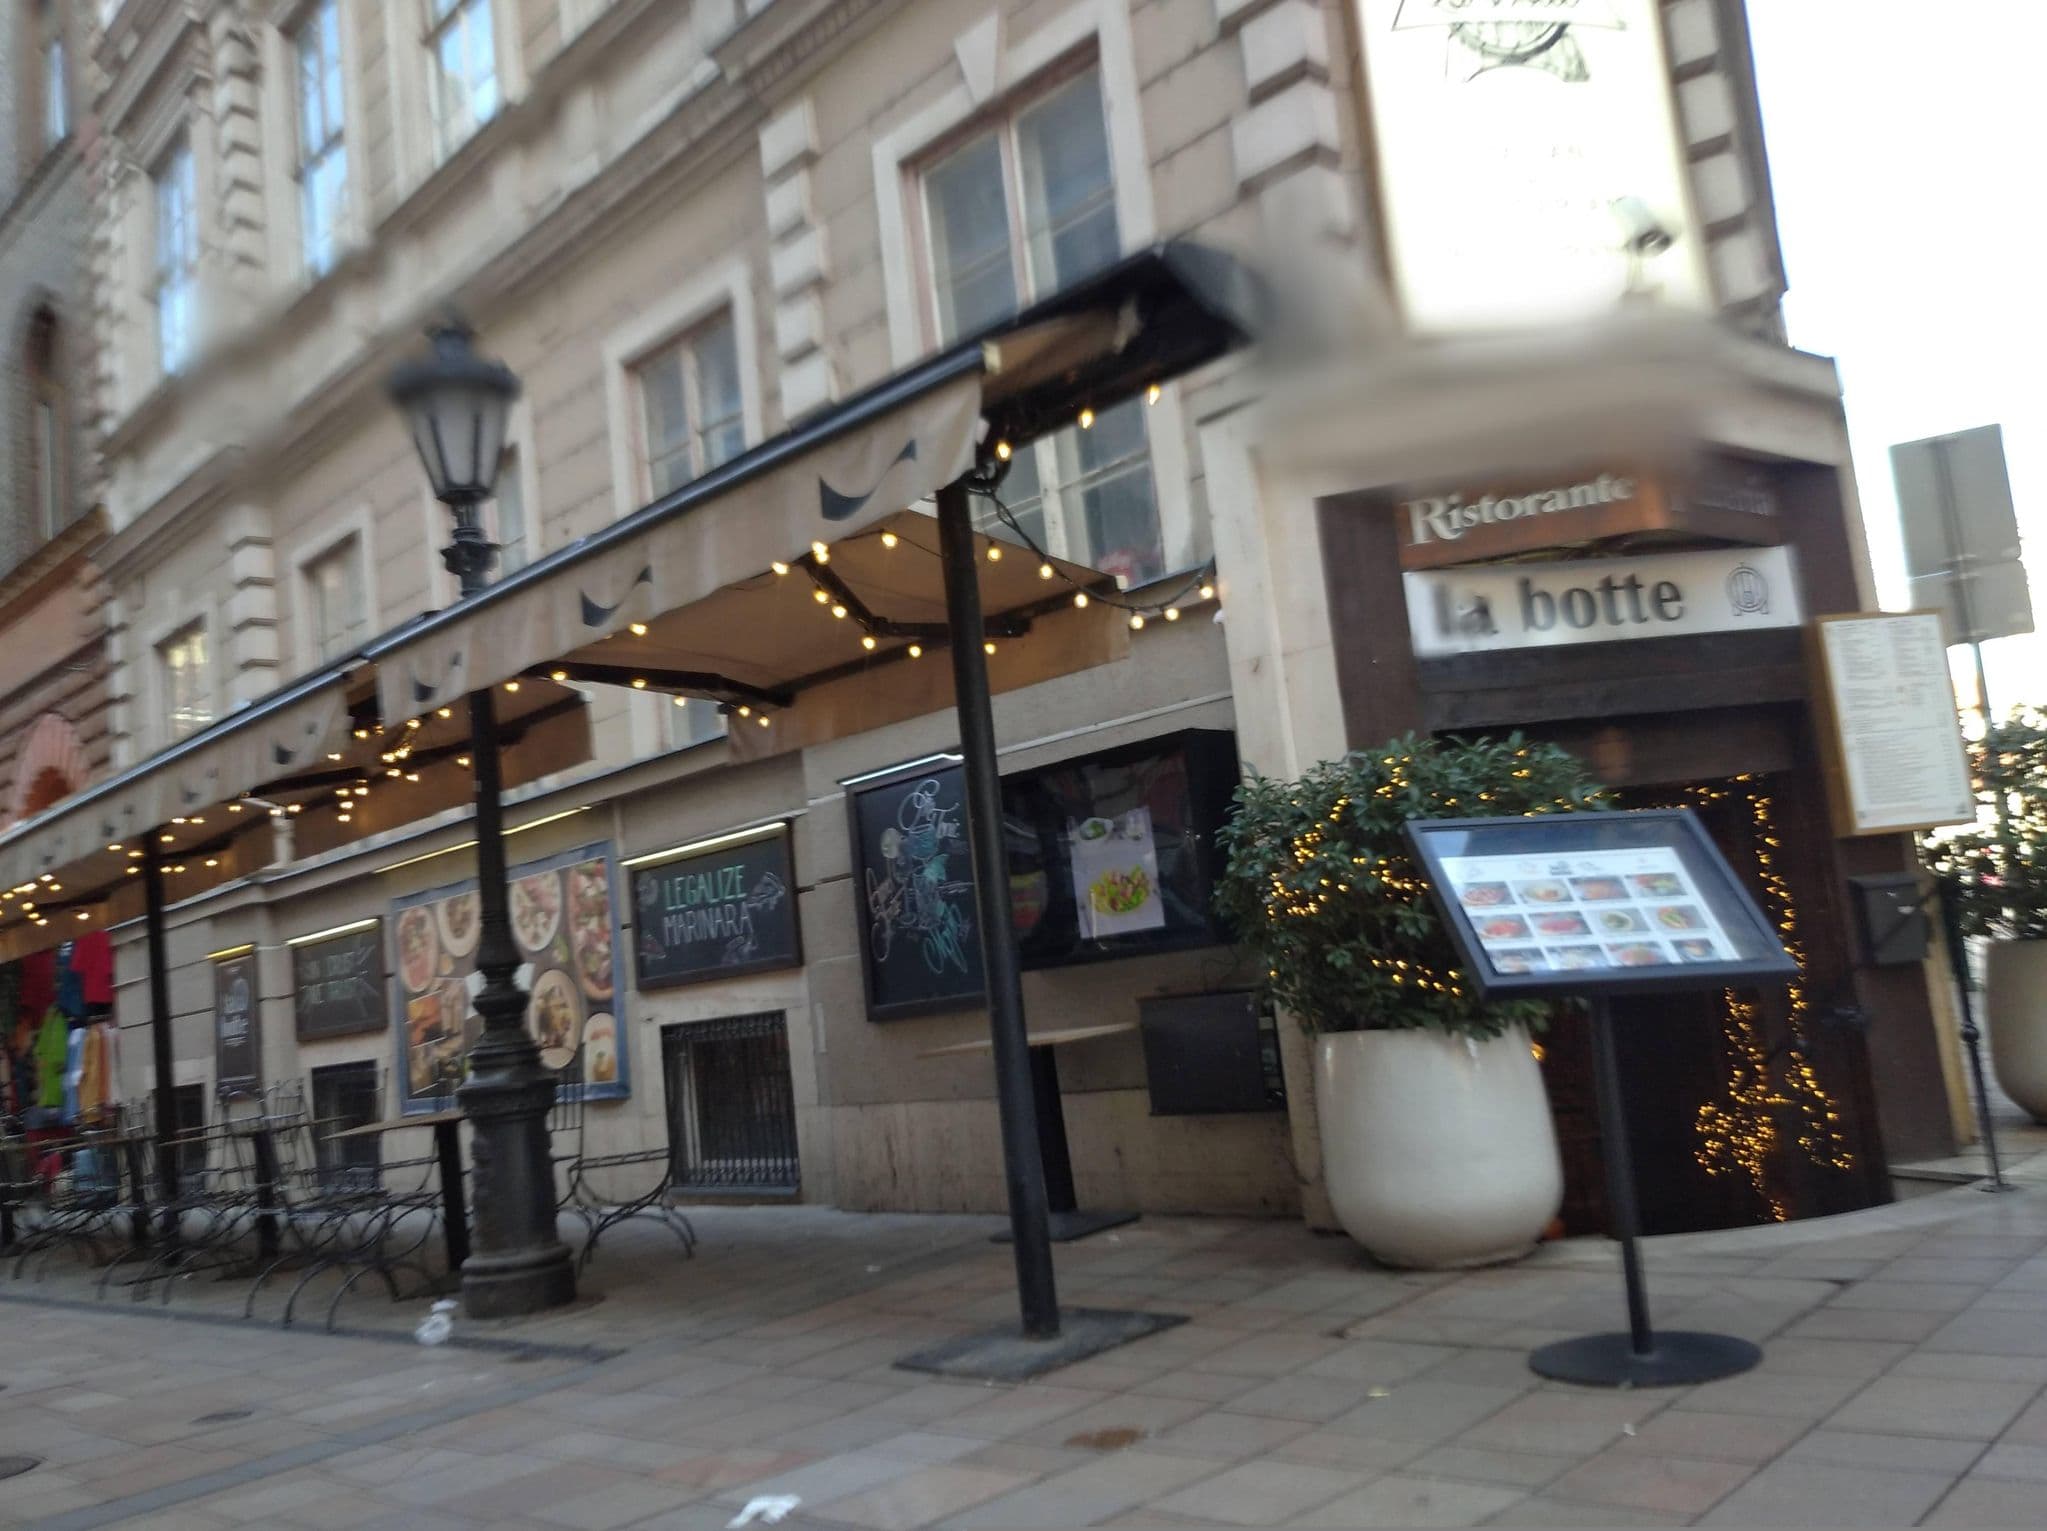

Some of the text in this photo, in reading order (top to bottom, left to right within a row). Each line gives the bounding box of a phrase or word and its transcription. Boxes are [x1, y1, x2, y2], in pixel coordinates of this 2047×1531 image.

[1402, 476, 1634, 546] Ristorante
[1517, 571, 1686, 633] botte
[663, 864, 748, 911] LEGALIZE
[663, 902, 753, 945] MARINARA
